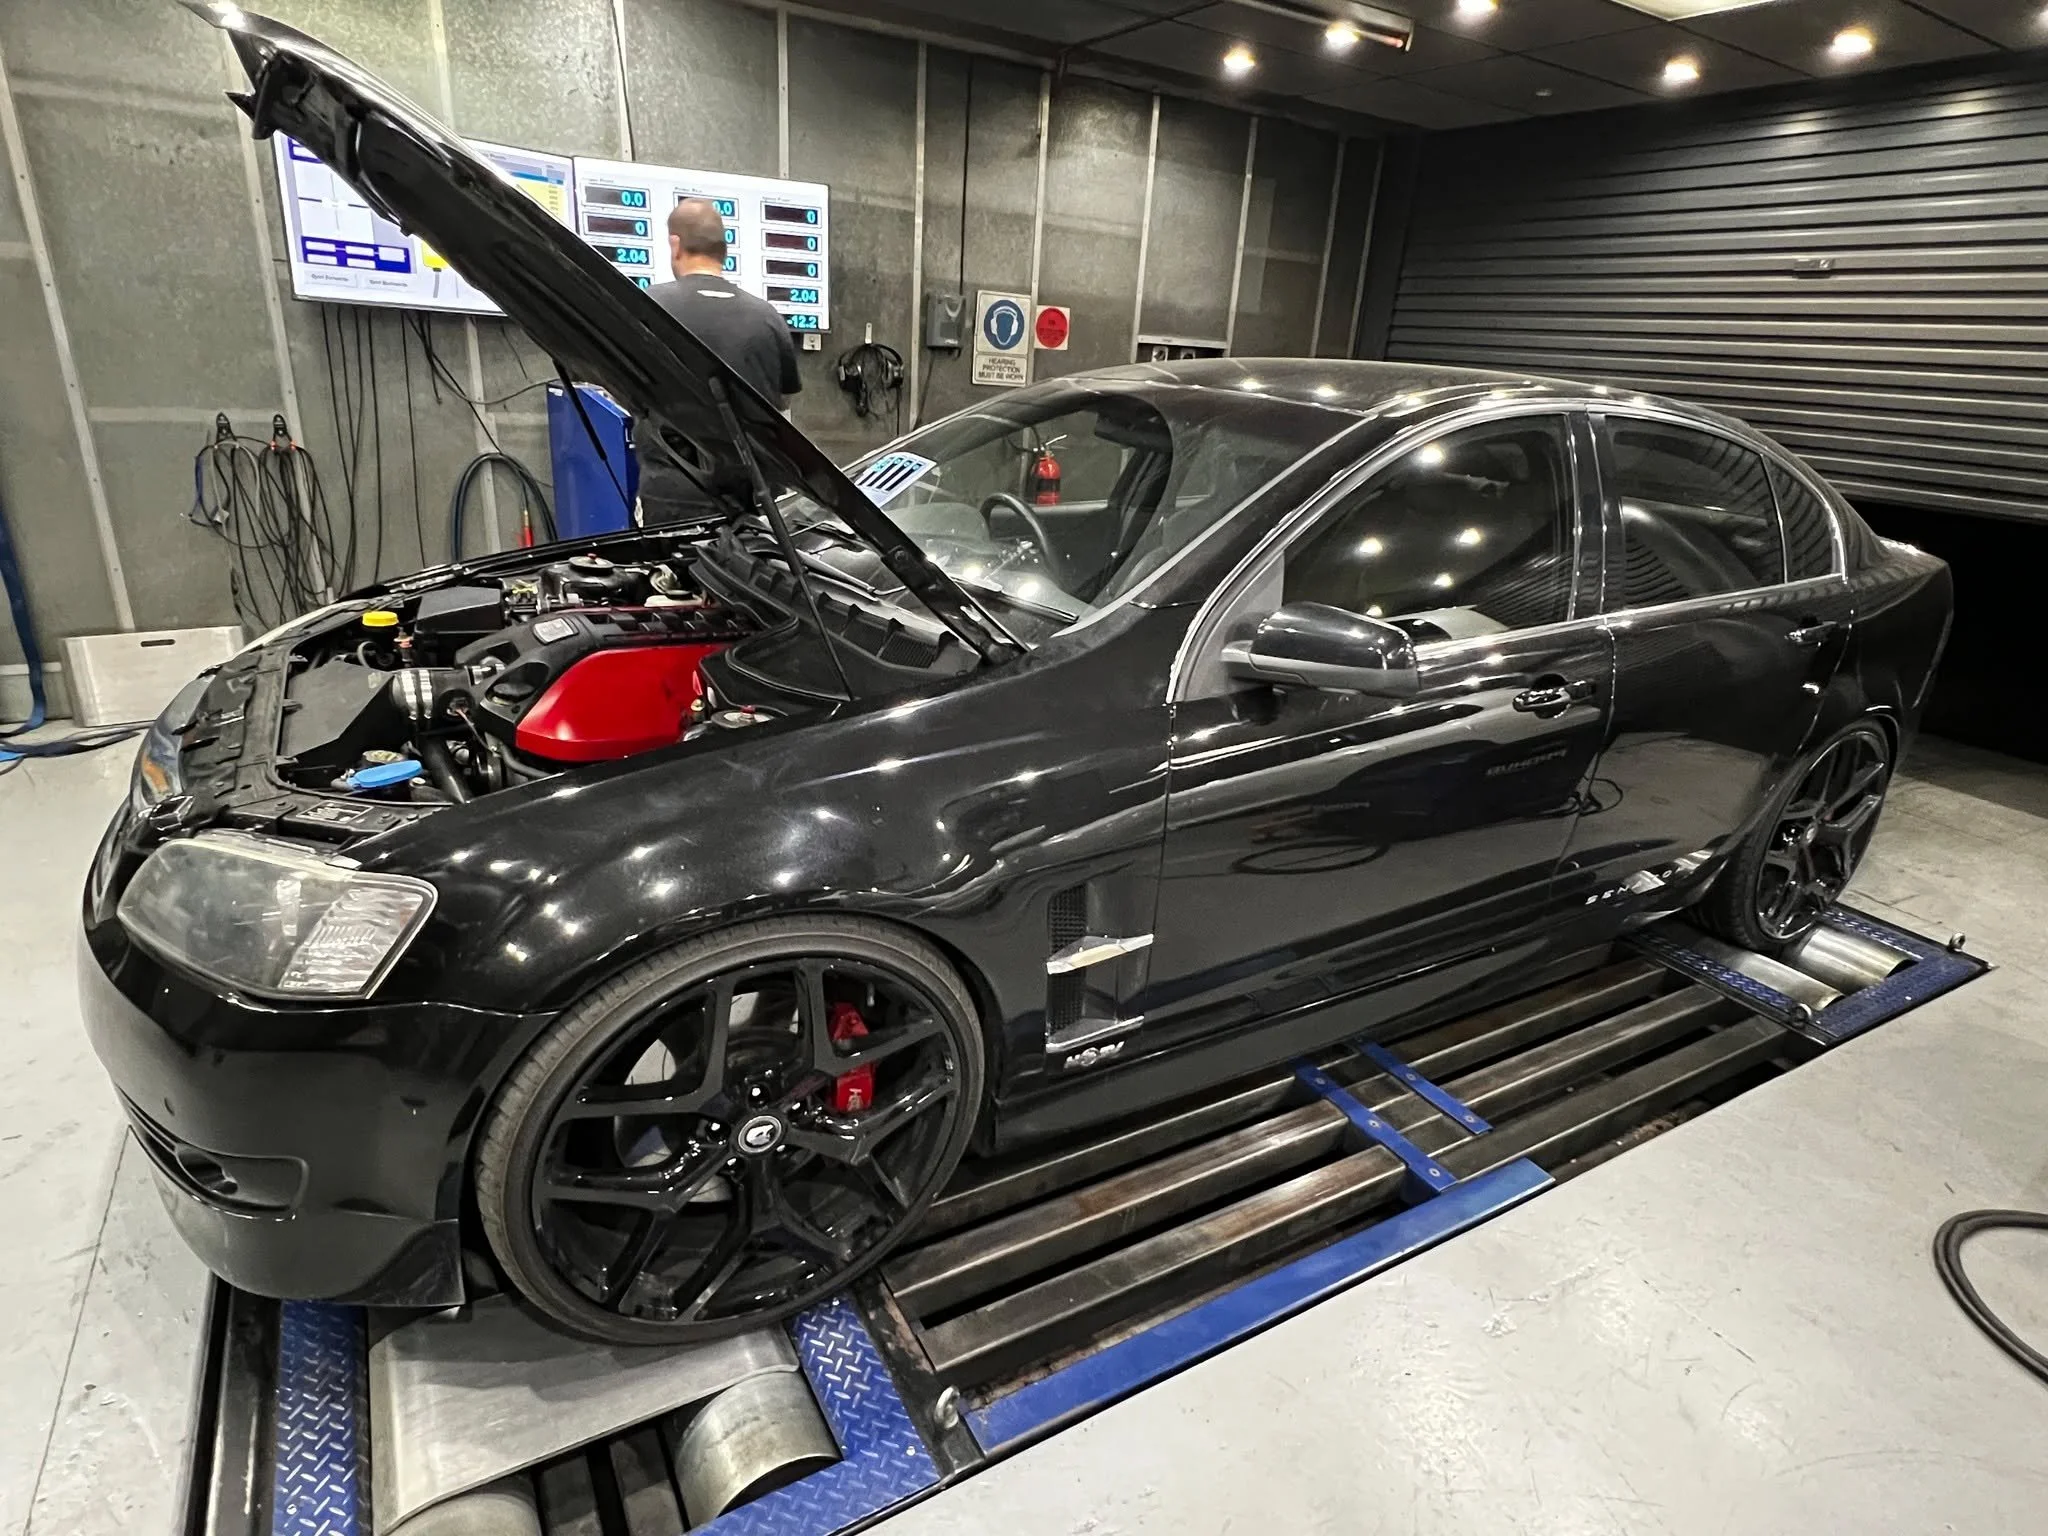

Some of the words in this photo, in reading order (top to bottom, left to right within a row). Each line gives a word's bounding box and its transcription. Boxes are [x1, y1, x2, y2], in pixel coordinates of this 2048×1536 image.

[621, 191, 644, 207] 0.0
[806, 210, 816, 224] 0
[635, 221, 646, 236] 0
[807, 238, 816, 251] 0
[616, 248, 648, 265] 2.04
[807, 264, 816, 278] 0
[789, 289, 817, 303] 2.04
[982, 364, 1021, 374] PROTECTION
[988, 358, 1016, 366] HEARING
[978, 371, 995, 379] MUST
[996, 372, 1004, 380] BE
[1005, 373, 1024, 381] WORN
